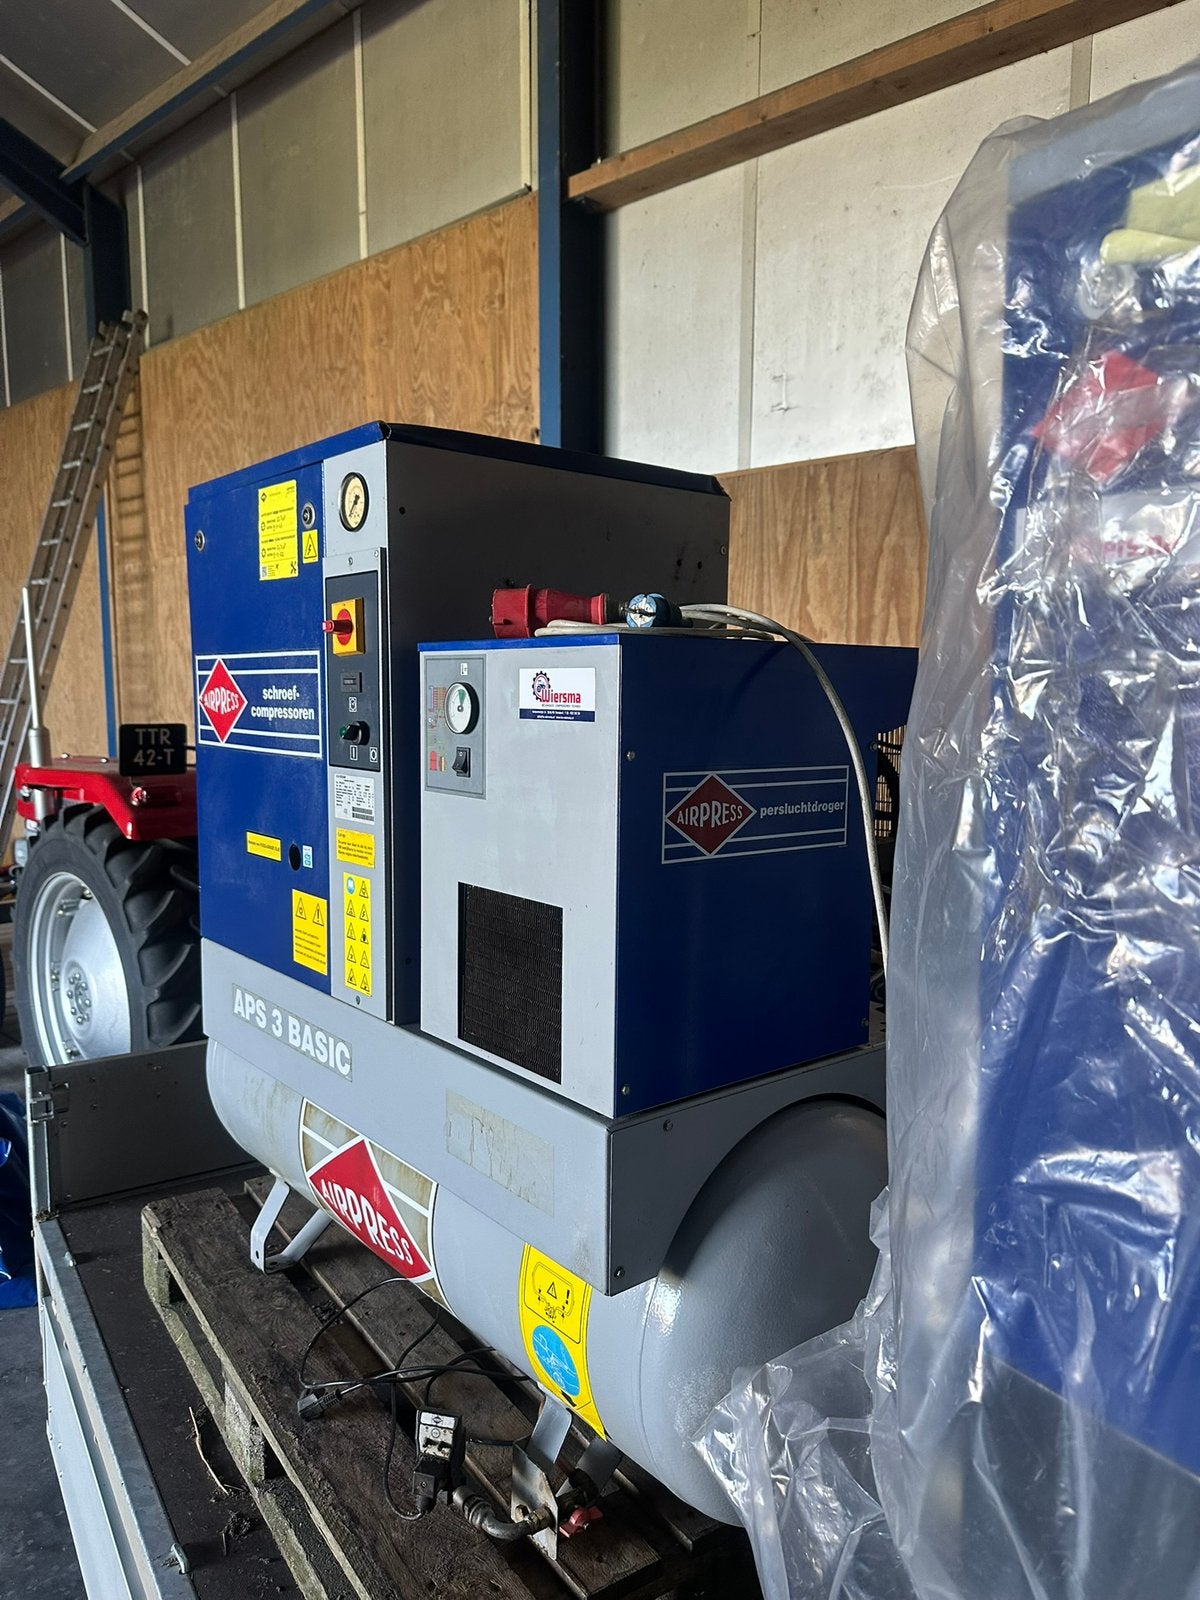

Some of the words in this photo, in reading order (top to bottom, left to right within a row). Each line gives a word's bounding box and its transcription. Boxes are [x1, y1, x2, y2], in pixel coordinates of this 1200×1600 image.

[204, 687, 239, 715] AIRPRESS
[262, 685, 300, 700] schroef-
[541, 690, 582, 704] Wiersma
[251, 706, 315, 721] compressoren
[134, 728, 171, 745] TTR
[133, 748, 175, 766] 42-T
[677, 800, 743, 828] AIRPRESS
[759, 801, 845, 819] persluchtdroger
[233, 988, 267, 1029] APS
[271, 1008, 283, 1038] 3
[288, 1015, 351, 1076] BASIC
[320, 1178, 414, 1266] AIRPRESS
